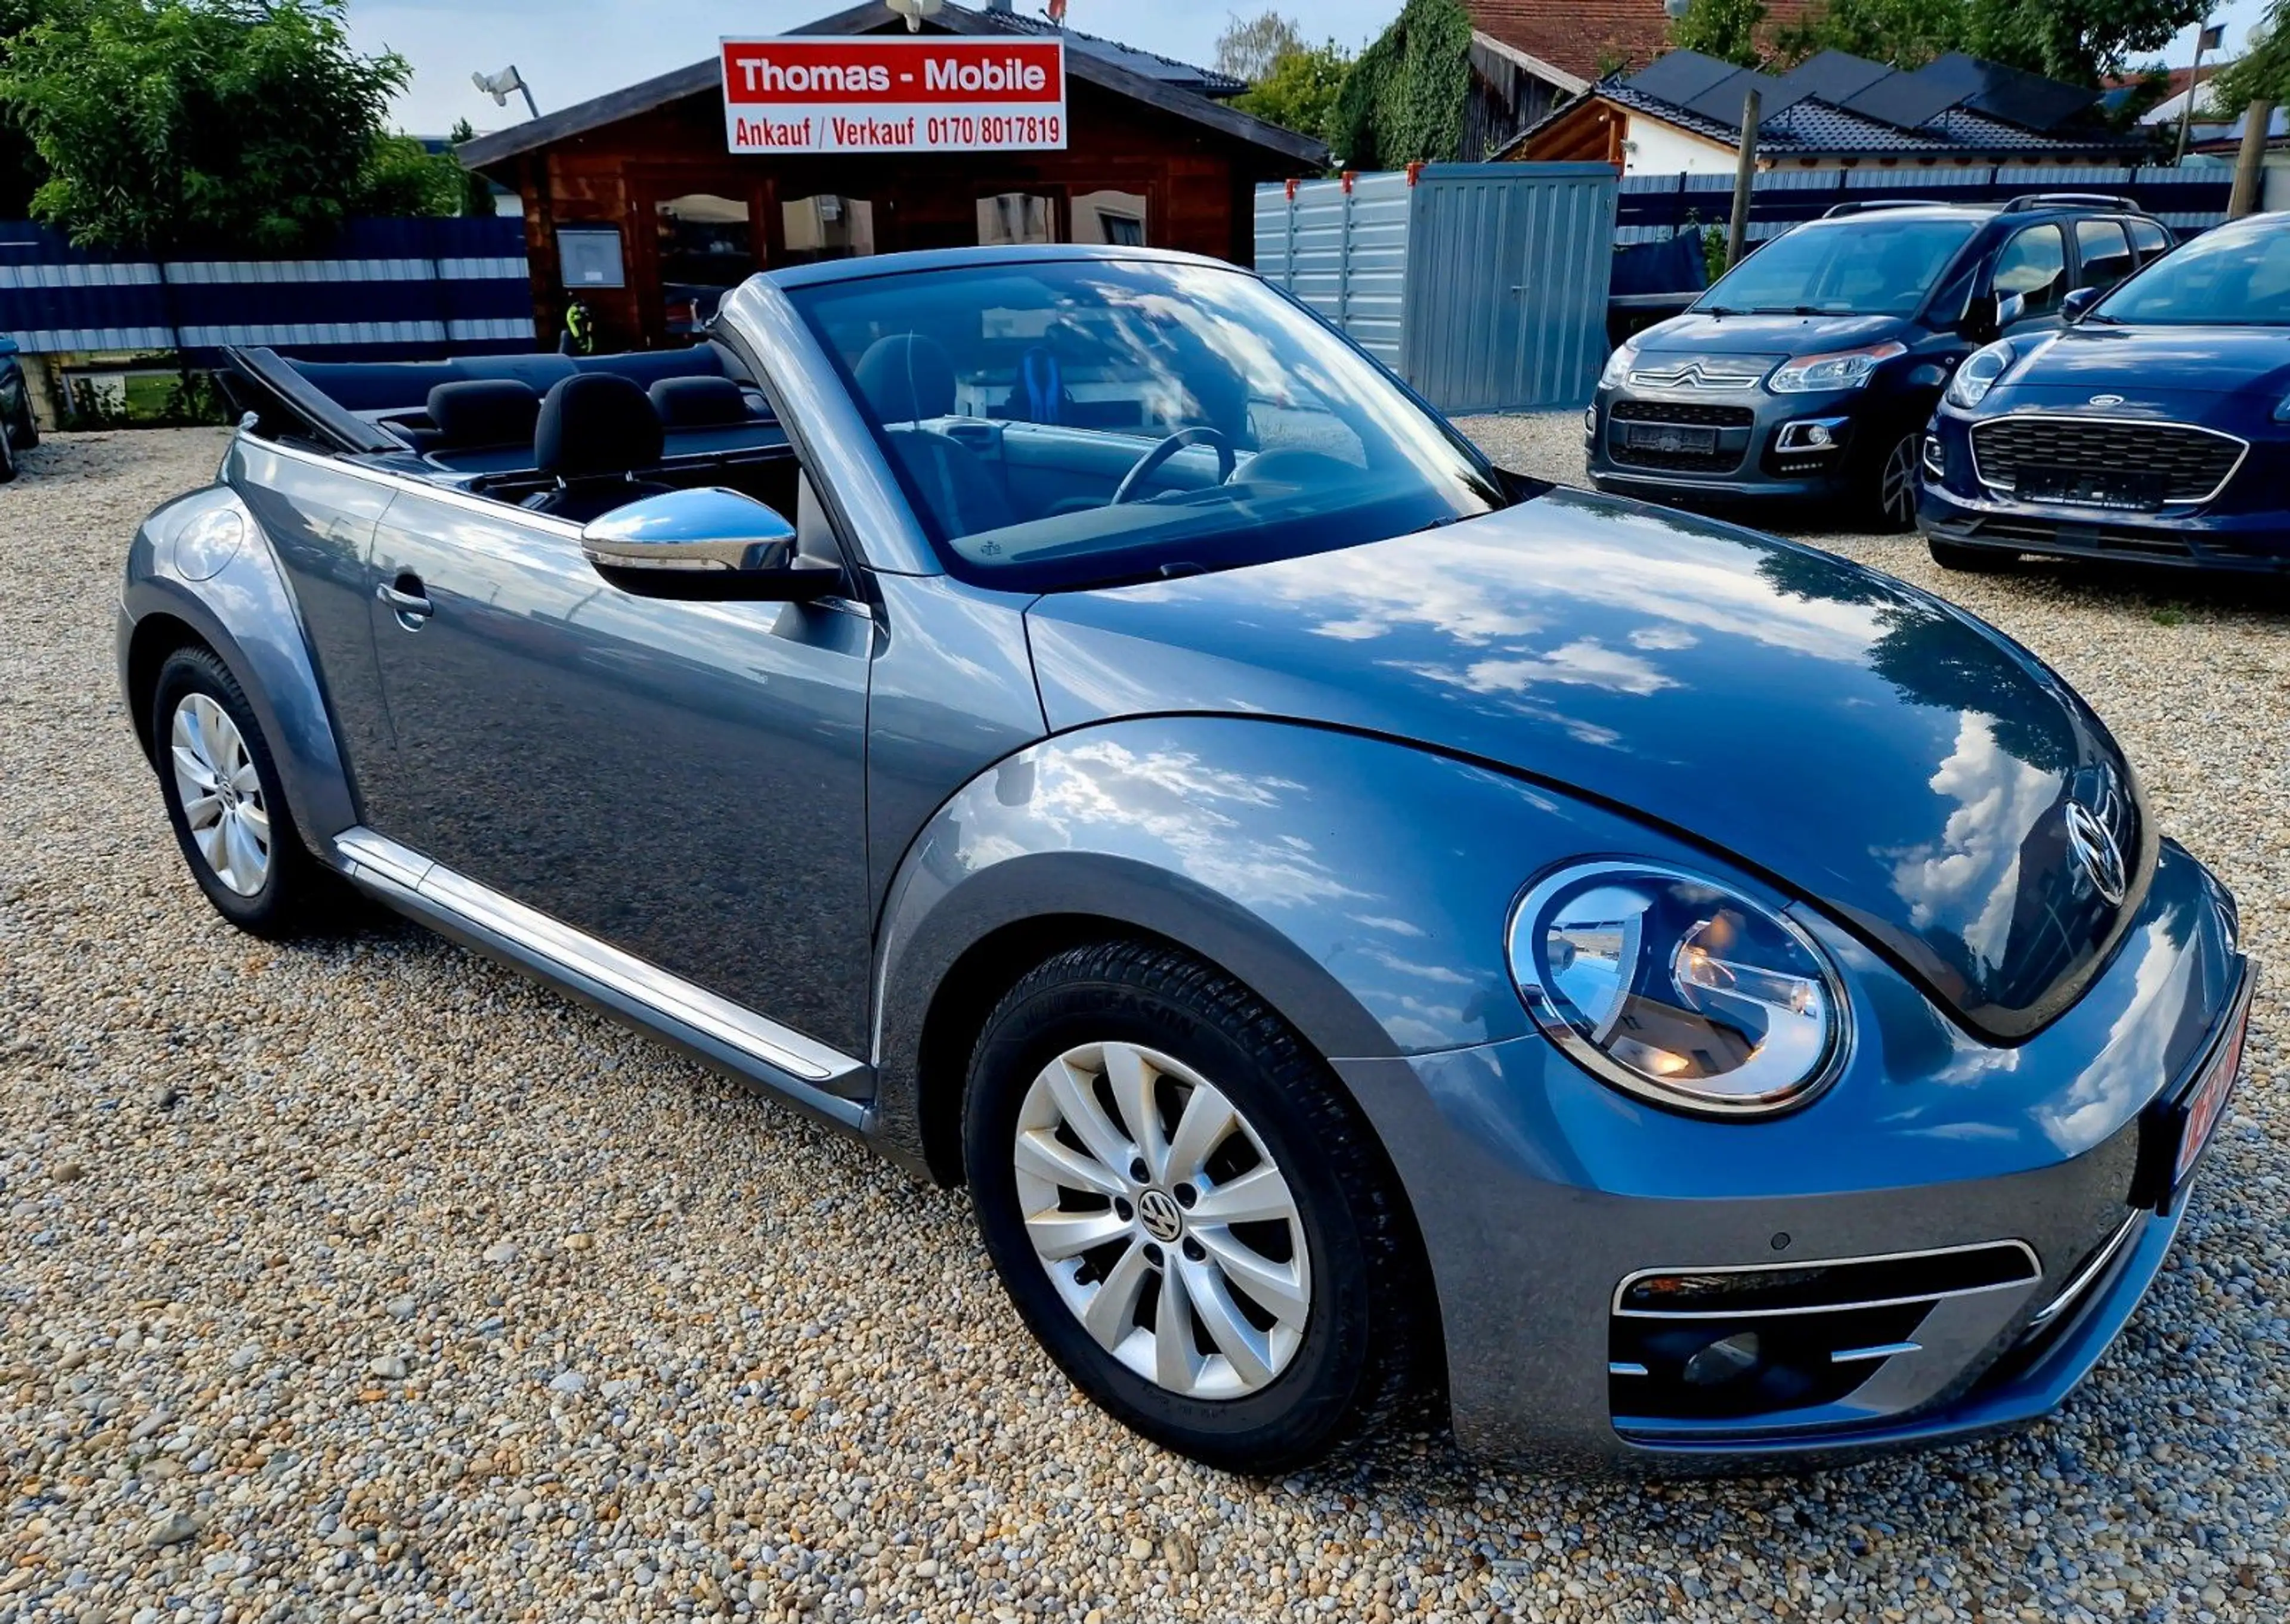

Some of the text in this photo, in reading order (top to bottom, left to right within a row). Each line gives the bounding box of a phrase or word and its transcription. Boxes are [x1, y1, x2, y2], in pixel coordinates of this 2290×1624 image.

[735, 57, 890, 91] Thomas
[924, 57, 1046, 91] Mobile
[736, 116, 811, 147] Ankauf
[832, 116, 915, 146] Verkauf
[927, 116, 1060, 147] 0170/8017819
